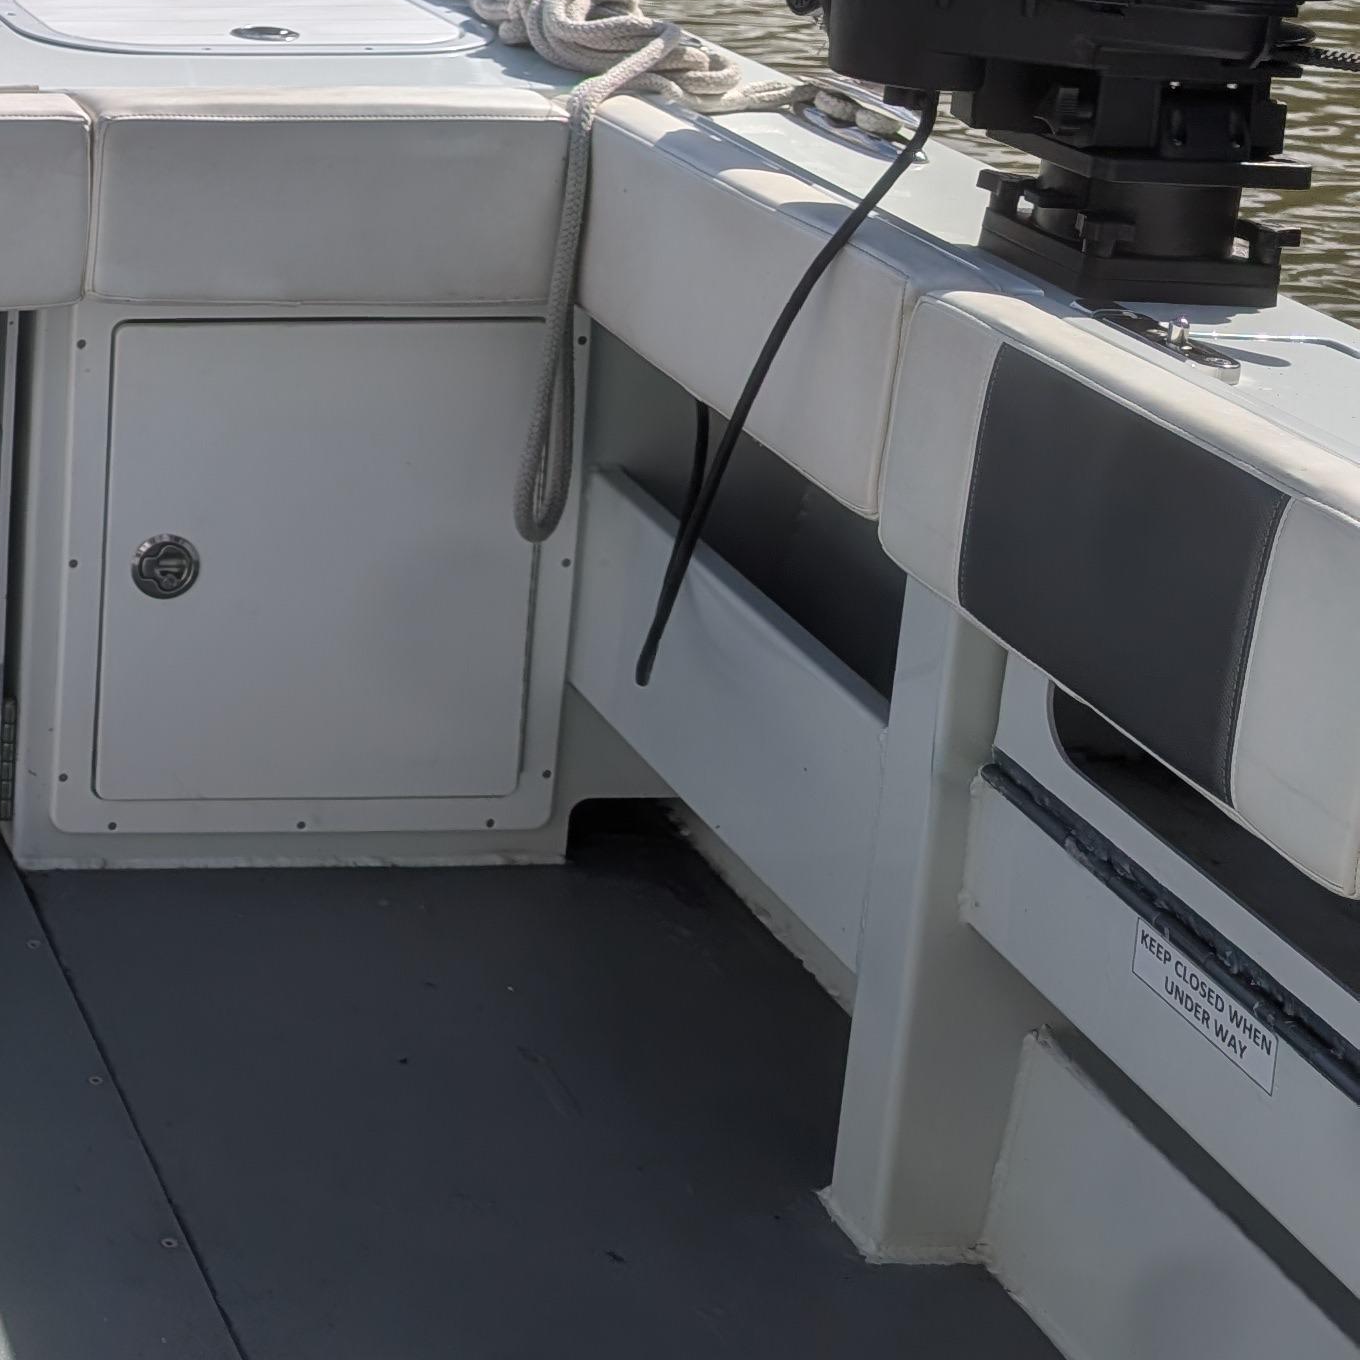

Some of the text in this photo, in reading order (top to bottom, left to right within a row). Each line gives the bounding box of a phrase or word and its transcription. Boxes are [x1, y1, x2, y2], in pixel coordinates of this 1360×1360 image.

[1140, 929, 1273, 1056] KEEP CLOSED WHEN
[1164, 975, 1248, 1059] UNDER WAY
